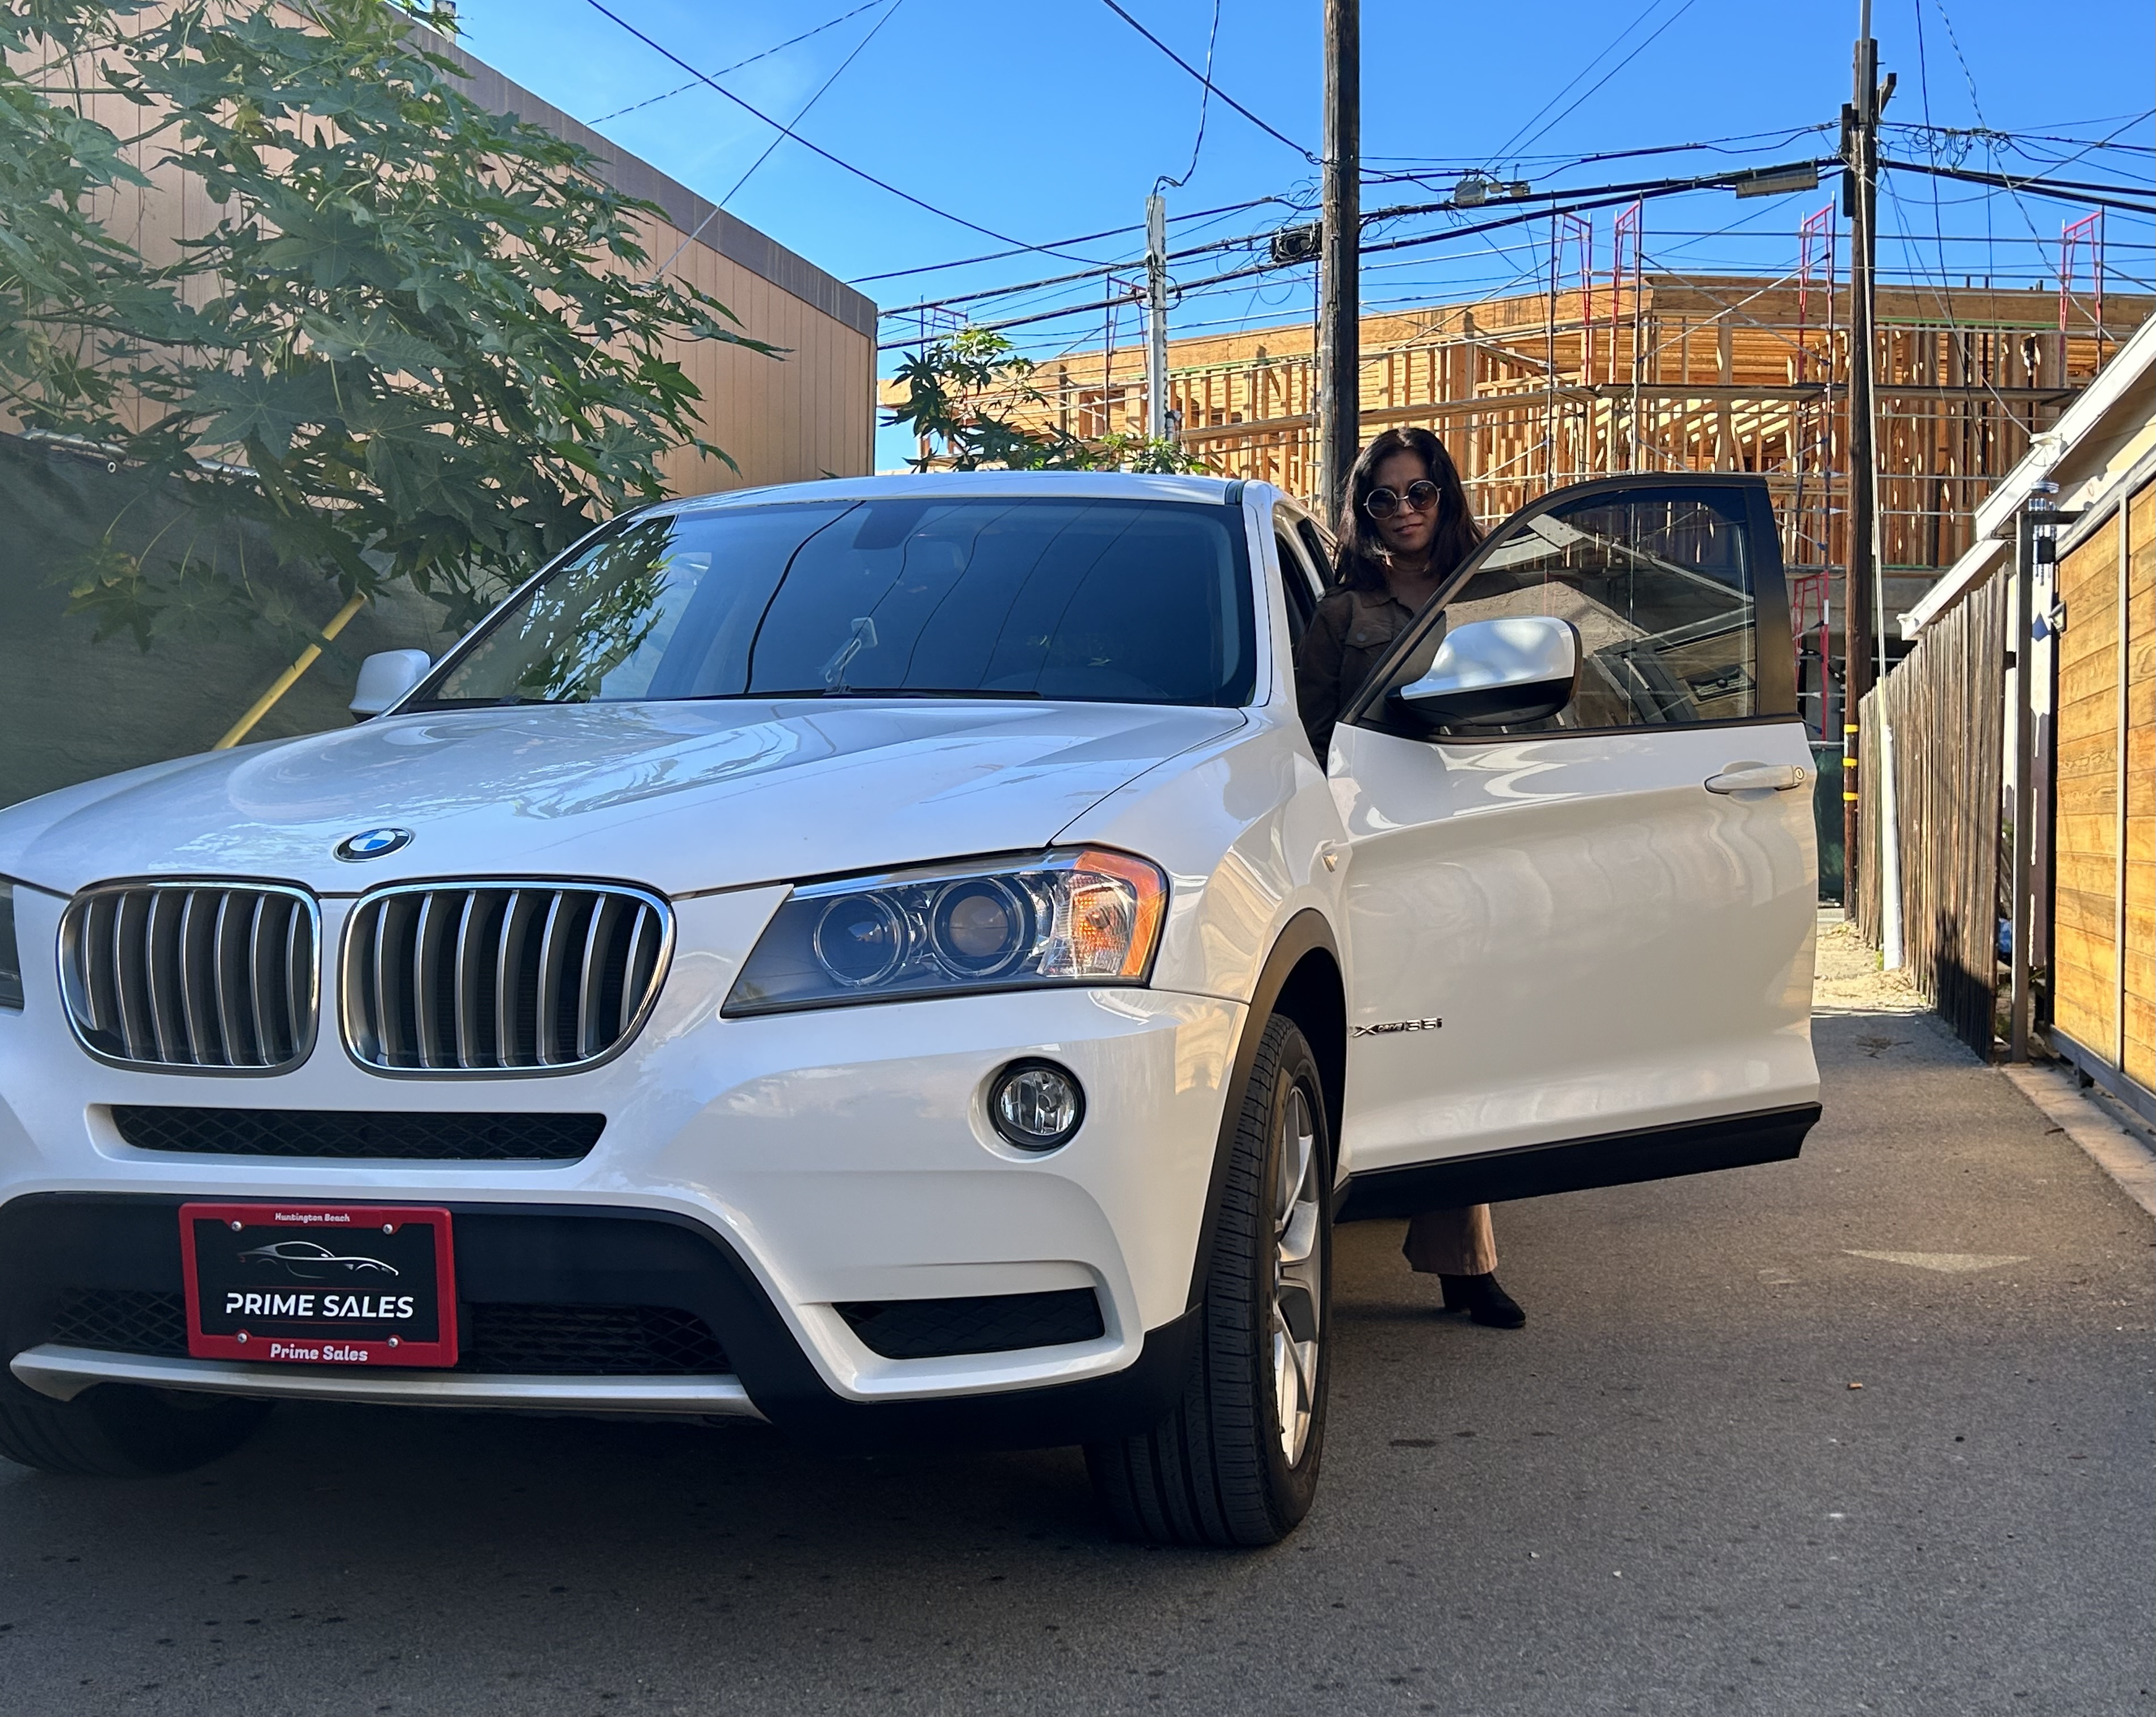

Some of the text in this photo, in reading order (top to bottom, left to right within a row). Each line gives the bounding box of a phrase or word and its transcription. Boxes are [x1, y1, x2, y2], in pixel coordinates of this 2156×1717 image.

[275, 1212, 350, 1224] Huntington Beach
[226, 1292, 414, 1318] PRIME SALES
[270, 1343, 368, 1362] Prime Sales
